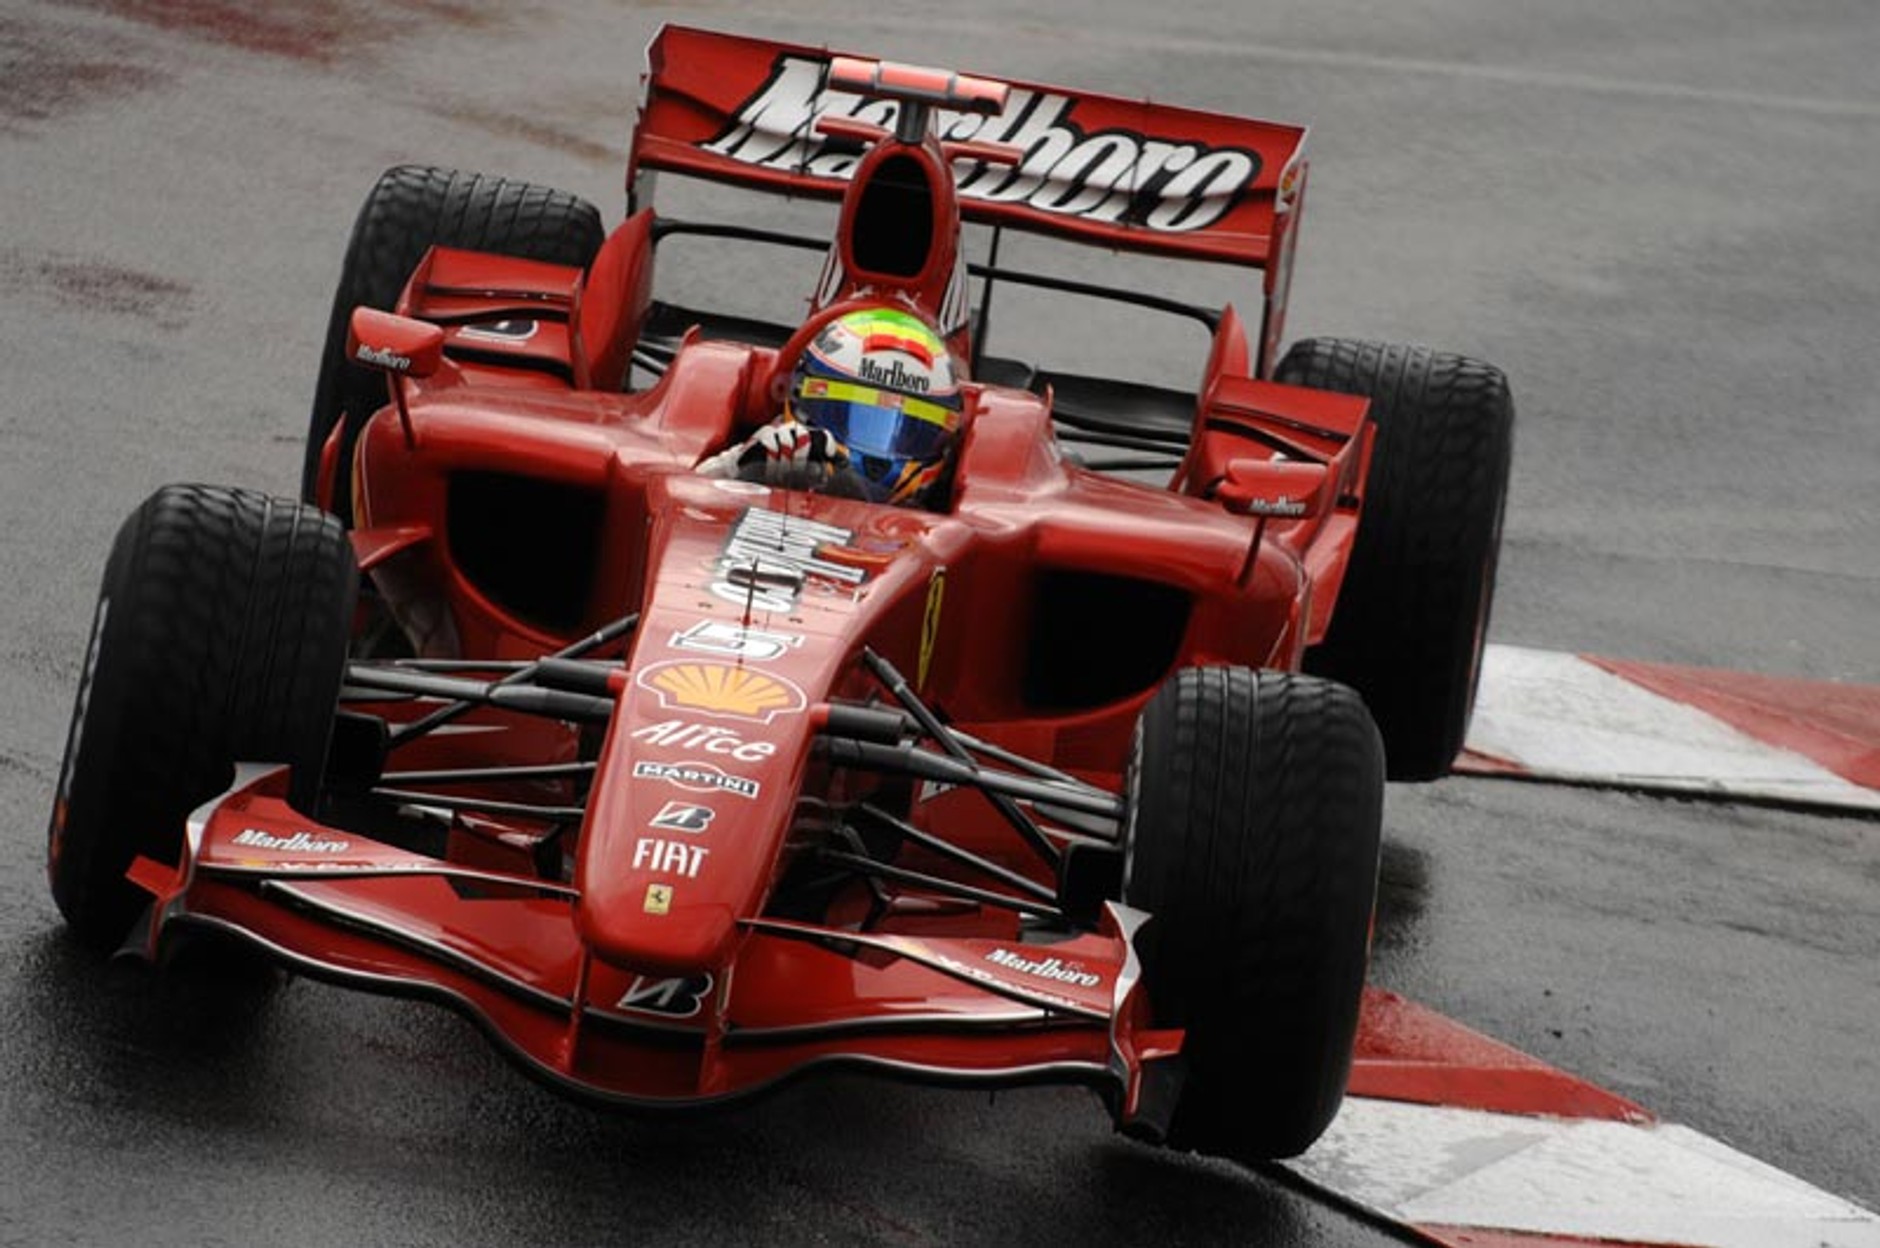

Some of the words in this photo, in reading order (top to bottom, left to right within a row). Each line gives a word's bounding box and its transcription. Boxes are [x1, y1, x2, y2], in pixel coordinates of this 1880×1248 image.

[356, 343, 410, 370] Marlboro
[858, 356, 930, 393] Marlboro
[667, 619, 805, 661] 5
[642, 763, 754, 795] MARTINI
[232, 829, 350, 853] Marlboro
[631, 838, 710, 878] FIAT
[984, 948, 1102, 987] Marlboro
